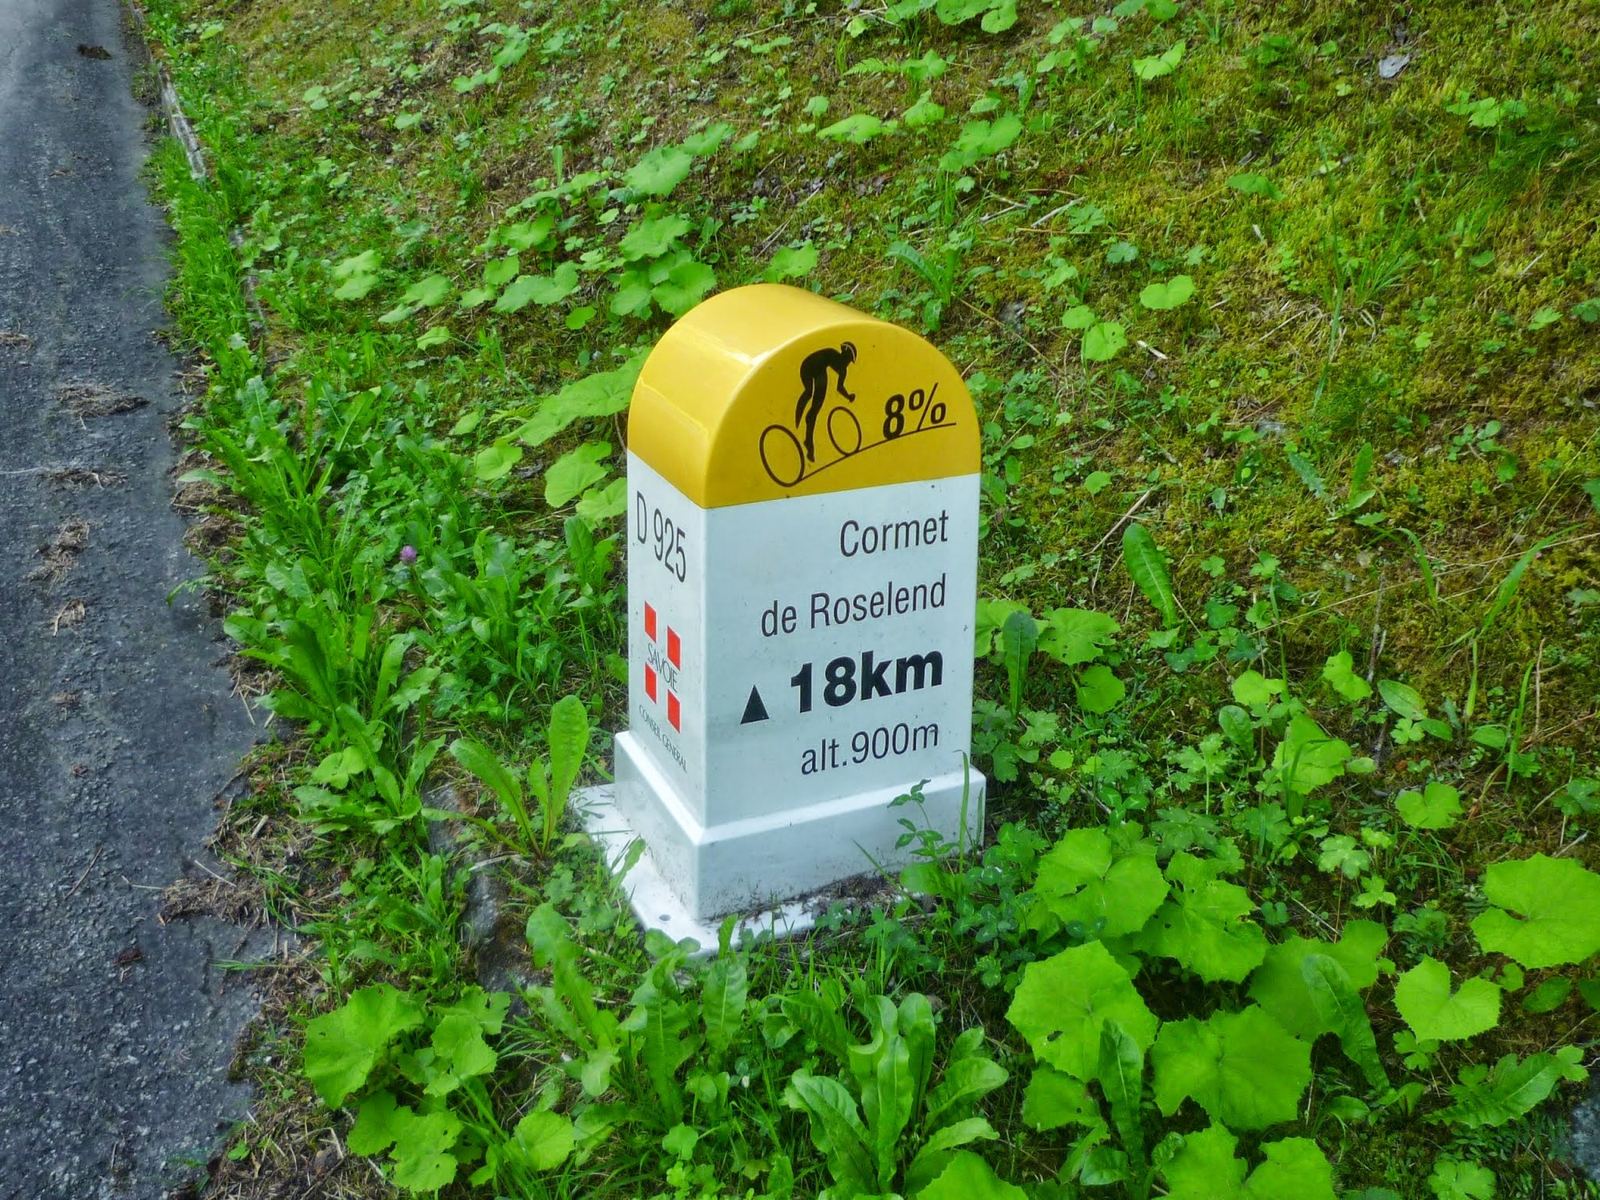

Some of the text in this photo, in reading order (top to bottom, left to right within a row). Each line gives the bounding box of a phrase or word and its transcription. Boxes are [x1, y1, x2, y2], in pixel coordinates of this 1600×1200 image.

[882, 382, 946, 440] 8%
[636, 491, 686, 583] D 925
[840, 510, 949, 557] Cormet
[761, 573, 946, 637] de Roselend
[647, 643, 678, 692] SAVOIE
[791, 650, 943, 713] 18km
[801, 722, 939, 775] alt.900m
